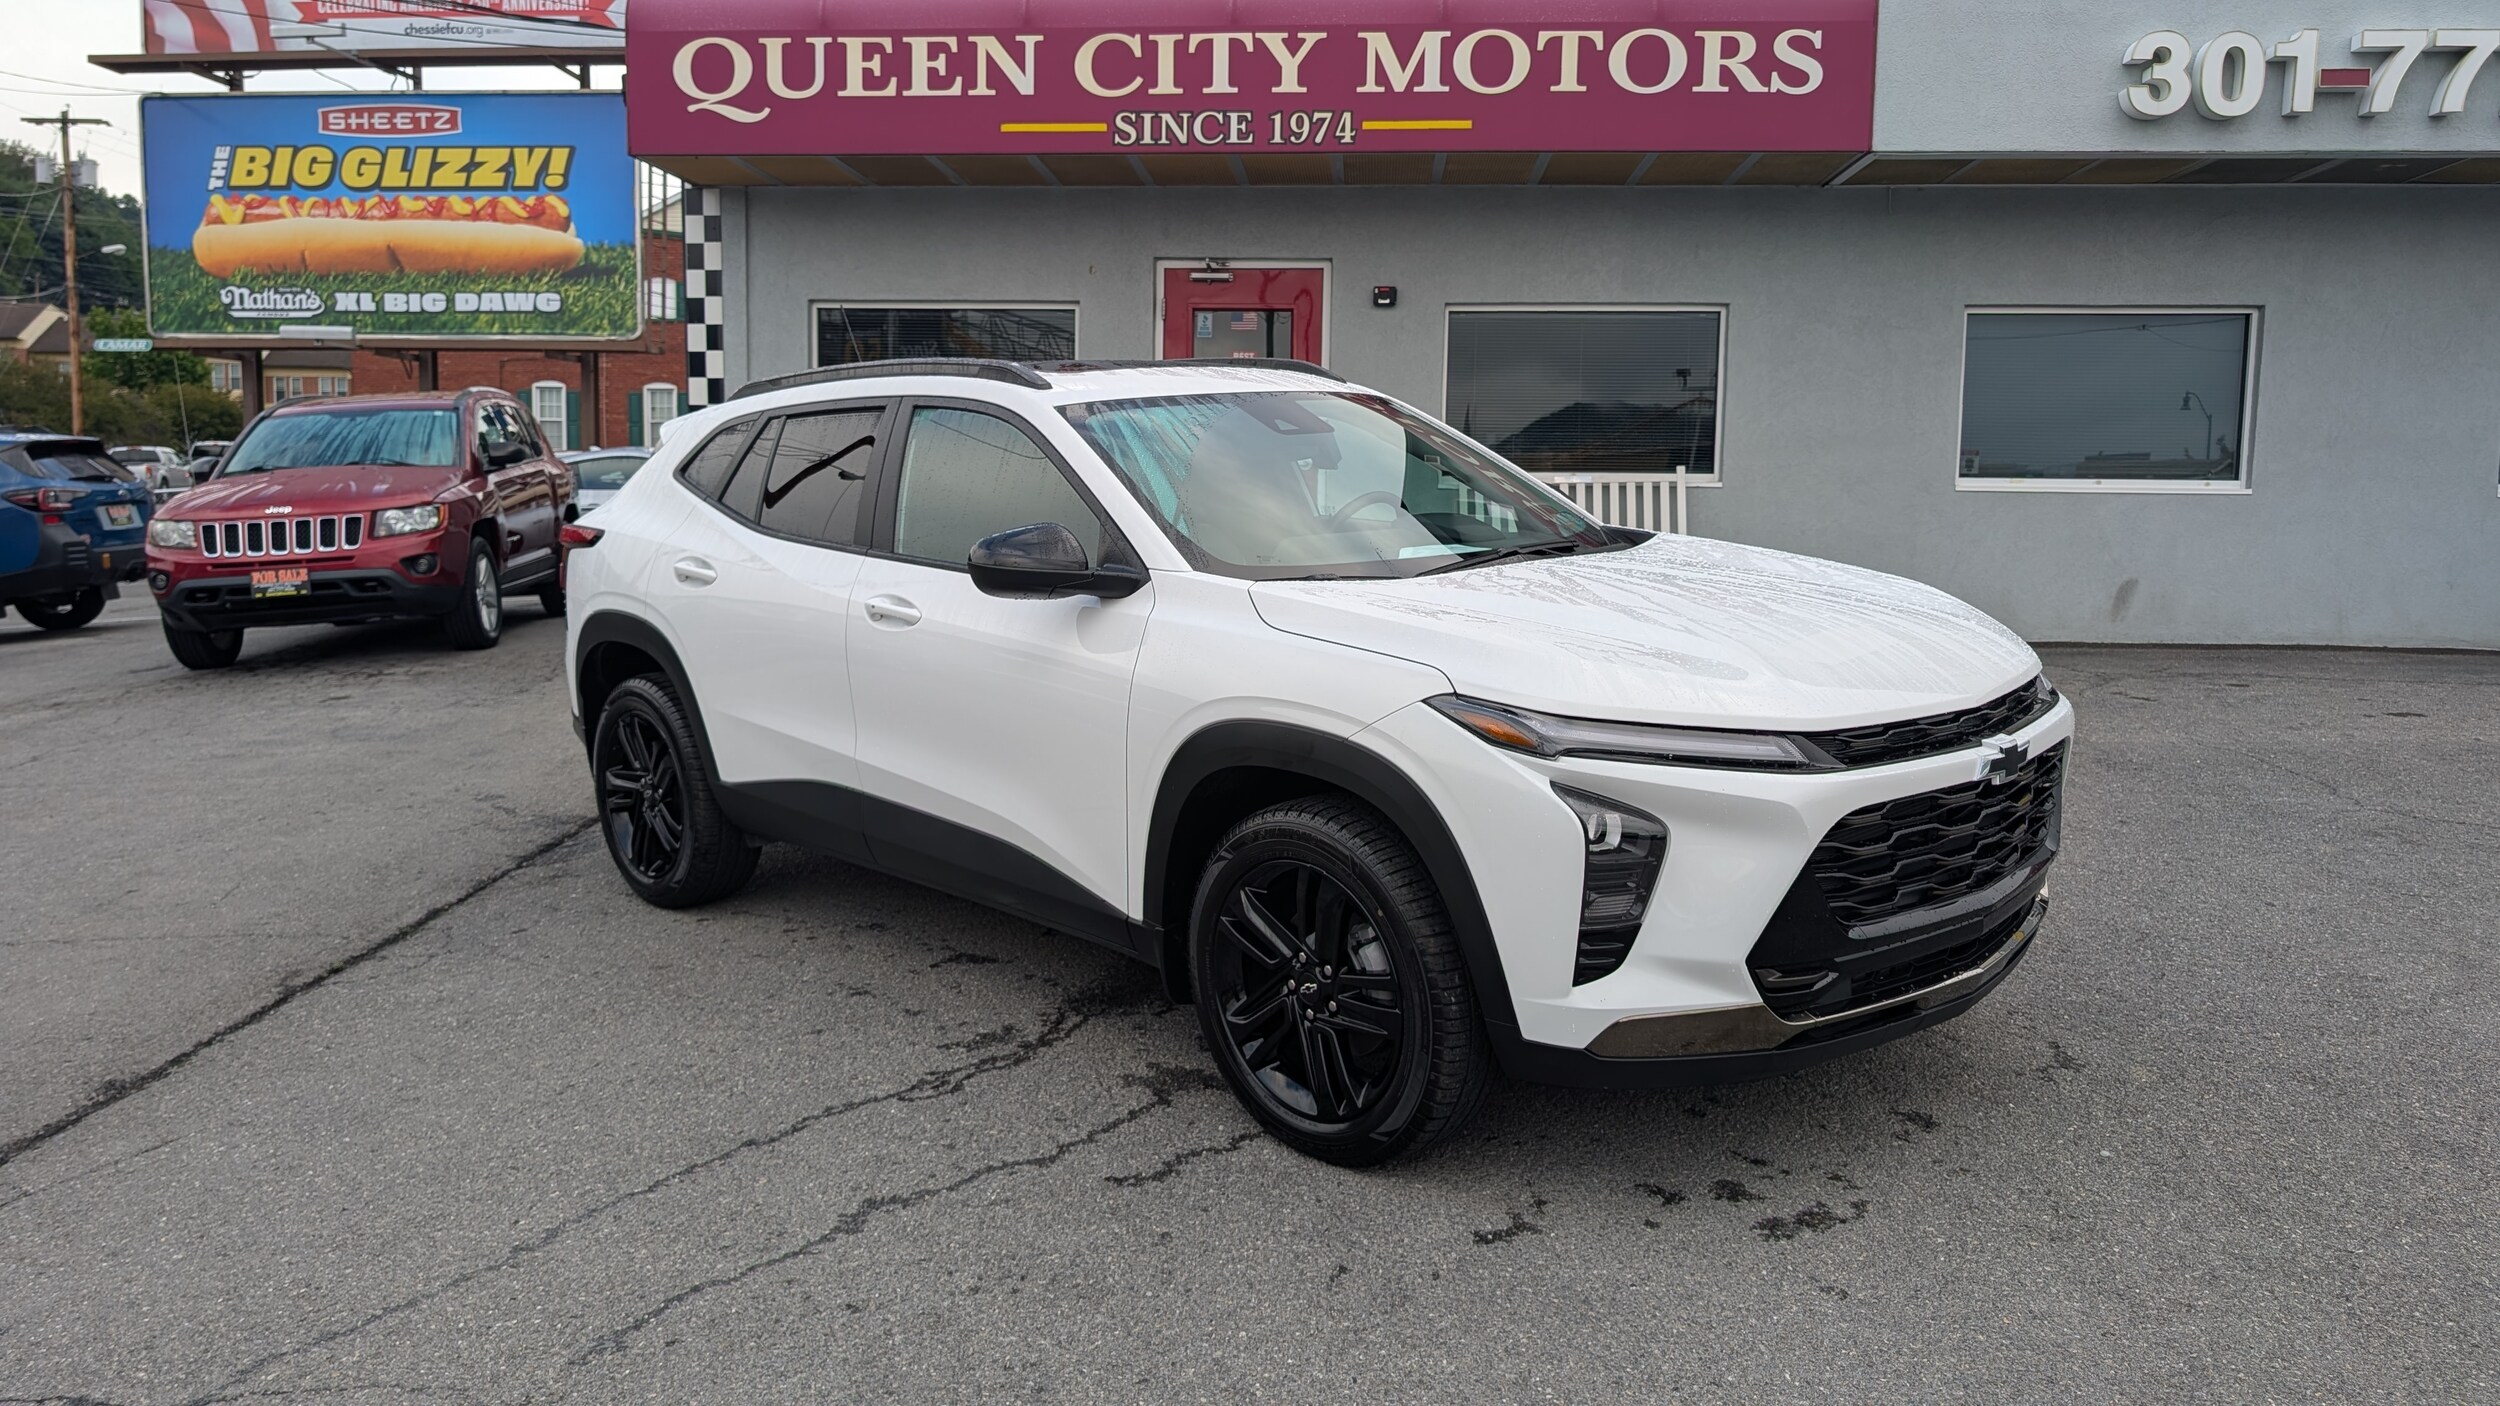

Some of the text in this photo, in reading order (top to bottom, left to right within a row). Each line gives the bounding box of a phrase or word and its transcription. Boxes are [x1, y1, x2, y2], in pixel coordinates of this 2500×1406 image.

[404, 23, 484, 38] chessiefcu.org
[672, 28, 1824, 123] QUEEN CITY MOTORS
[327, 111, 453, 131] SHEETZ
[1113, 111, 1357, 146] SINCE 1974
[208, 145, 231, 191] THE
[228, 146, 572, 189] BIG GLIZZY!
[219, 286, 322, 311] Nathan's
[334, 292, 562, 312] XL BIG DAWG
[98, 341, 148, 350] LAMAR
[264, 505, 293, 514] Jeep
[251, 570, 277, 585] FOR
[278, 568, 309, 582] SALE
